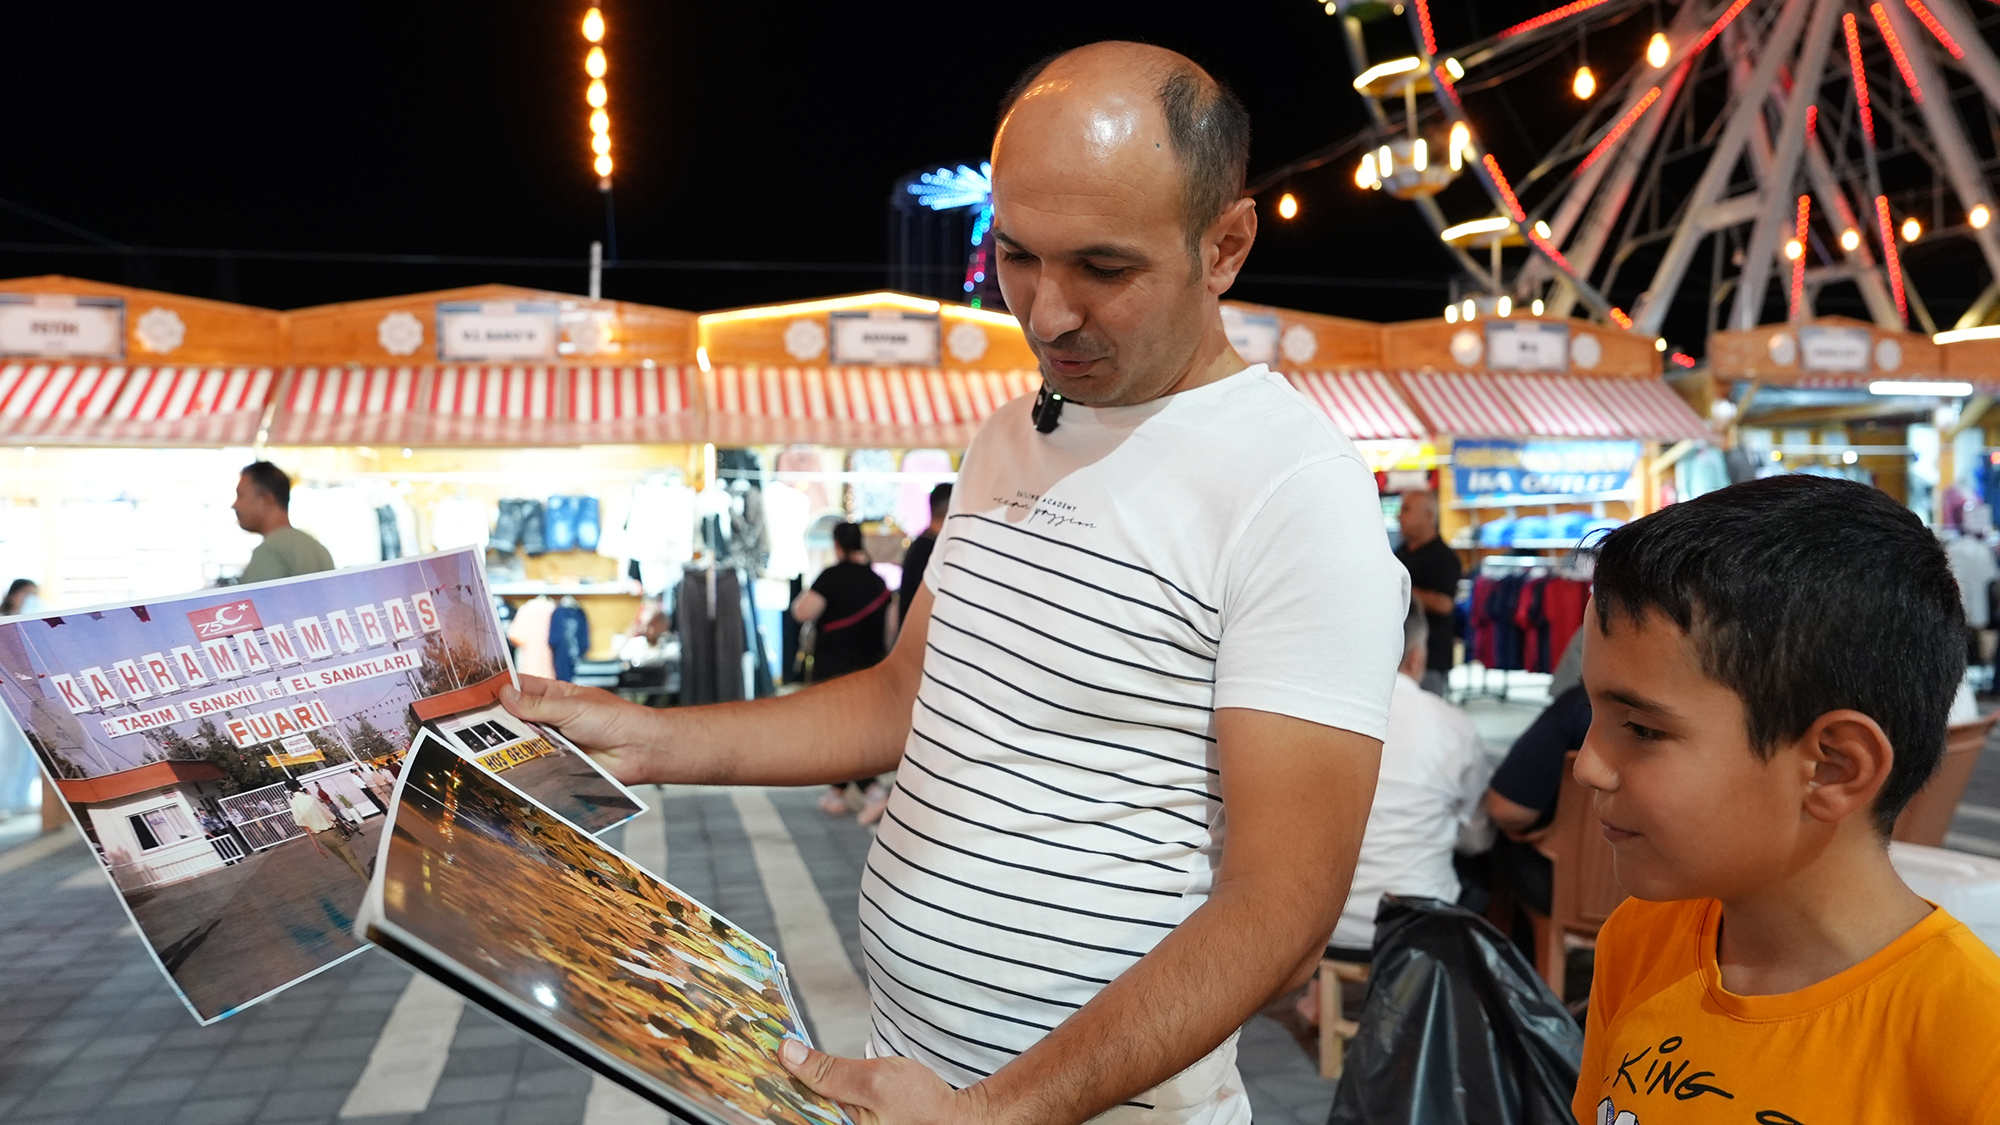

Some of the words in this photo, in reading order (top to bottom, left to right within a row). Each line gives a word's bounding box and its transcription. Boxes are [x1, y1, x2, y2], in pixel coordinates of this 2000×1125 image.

[1042, 497, 1077, 512] ACADEMY
[57, 598, 436, 708] KAHRAMANMARAŞ
[118, 708, 176, 732] TARIM
[189, 686, 257, 715] SANAYİİ
[266, 687, 281, 697] VE
[292, 676, 316, 691] EL
[321, 653, 413, 685] SANATLARI
[228, 702, 330, 745] FUARI
